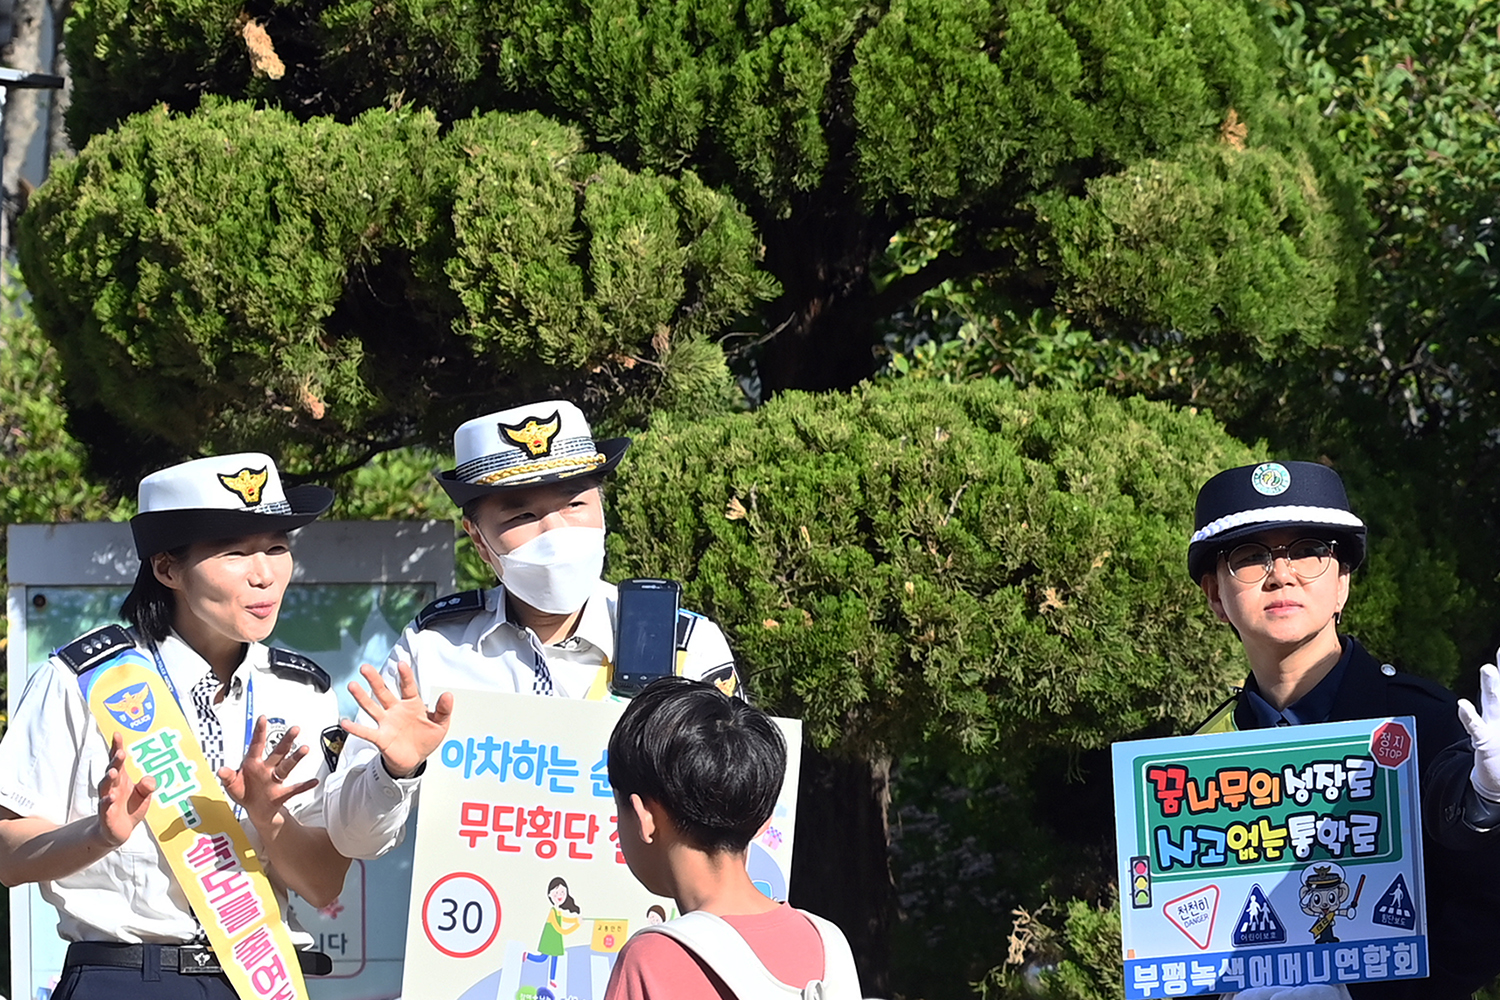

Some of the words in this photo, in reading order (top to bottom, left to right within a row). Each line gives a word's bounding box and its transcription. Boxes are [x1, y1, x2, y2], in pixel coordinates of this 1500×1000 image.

[129, 713, 152, 728] POLICE
[1378, 747, 1403, 759] STOP
[1380, 731, 1405, 749] 정지
[440, 735, 580, 794] 아차하는
[1284, 757, 1375, 804] 성장로
[459, 801, 600, 860] 무단횡단
[185, 834, 261, 934] 속도를
[437, 898, 483, 934] 30
[1177, 896, 1210, 921] 천천히
[1184, 912, 1209, 929] DANGER
[1132, 941, 1418, 996] 부평녹색어머니연합회
